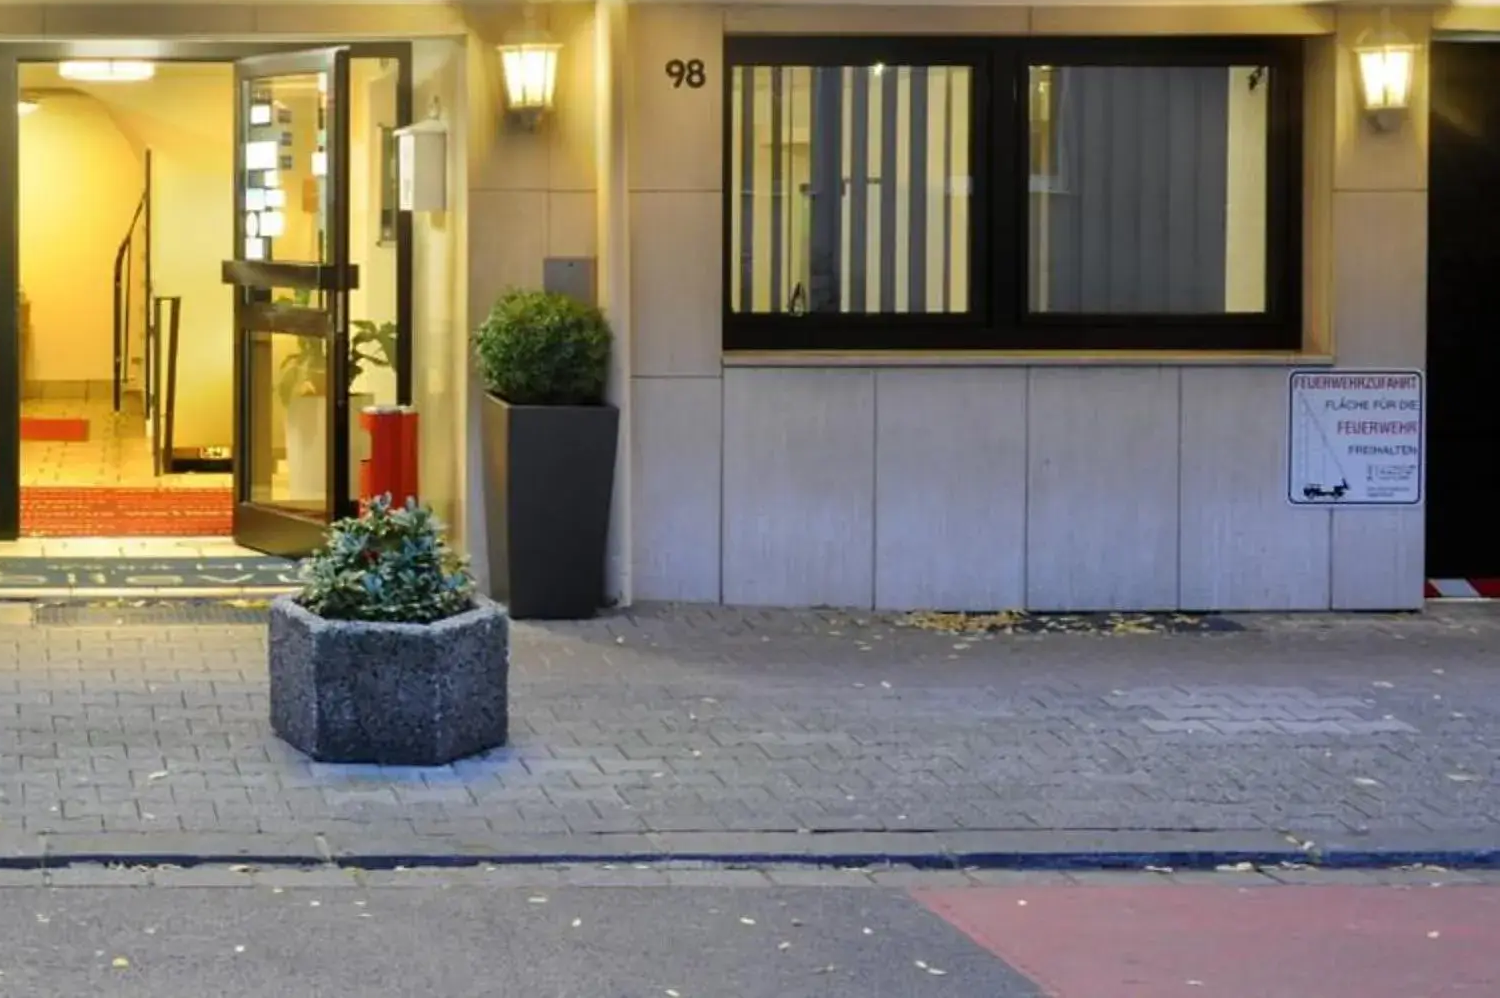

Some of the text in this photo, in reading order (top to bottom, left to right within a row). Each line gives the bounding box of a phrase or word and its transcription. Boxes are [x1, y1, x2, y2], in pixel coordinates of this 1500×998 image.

[665, 58, 706, 89] 98
[1294, 376, 1417, 390] FEUERWEHRZUFAHRT
[1337, 420, 1417, 435] FEUERWEHR
